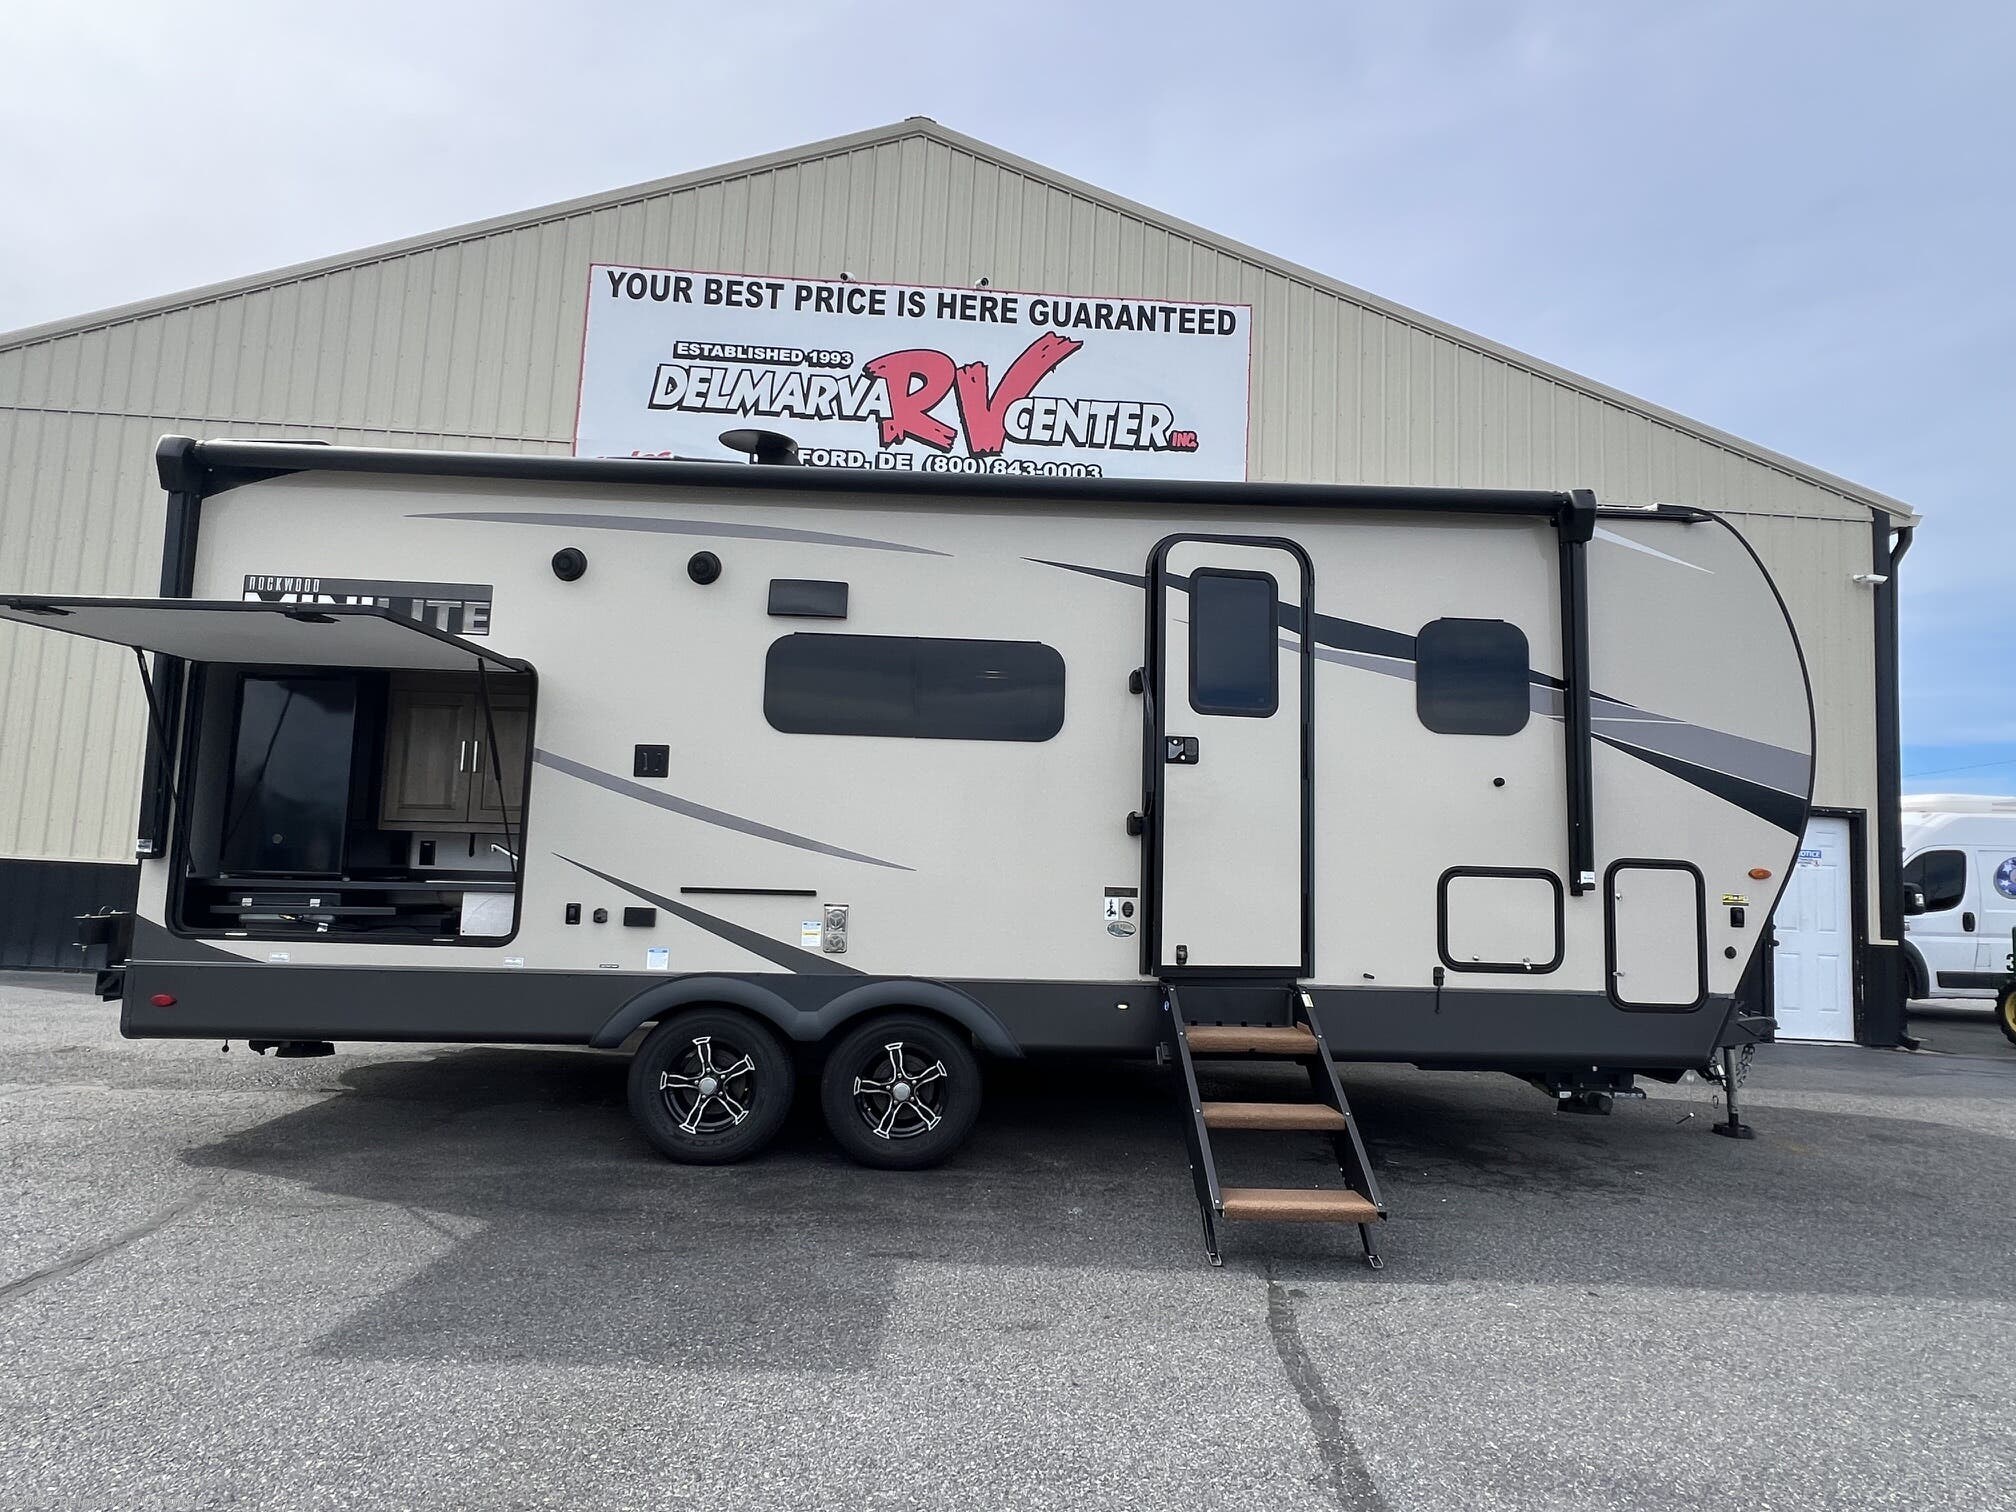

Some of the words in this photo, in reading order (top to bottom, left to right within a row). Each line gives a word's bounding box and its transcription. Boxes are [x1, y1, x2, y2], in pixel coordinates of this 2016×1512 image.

[607, 270, 692, 304] YOUR
[704, 278, 784, 310] BEST
[794, 284, 887, 316] PRICE
[898, 289, 926, 318] IS
[936, 292, 1019, 324] HERE
[1029, 299, 1236, 336] GUARANTEED
[674, 341, 804, 366] ESTABLISHED
[807, 349, 853, 369] 1993
[648, 363, 894, 421] DELMARVA
[861, 331, 1084, 459] RV
[1002, 396, 1174, 452] CENTER
[875, 452, 913, 470] DE
[922, 454, 988, 473] (800)
[992, 459, 1103, 478] 843-0003
[249, 576, 320, 593] ROCKWOOD
[1799, 850, 1821, 858] OTICE
